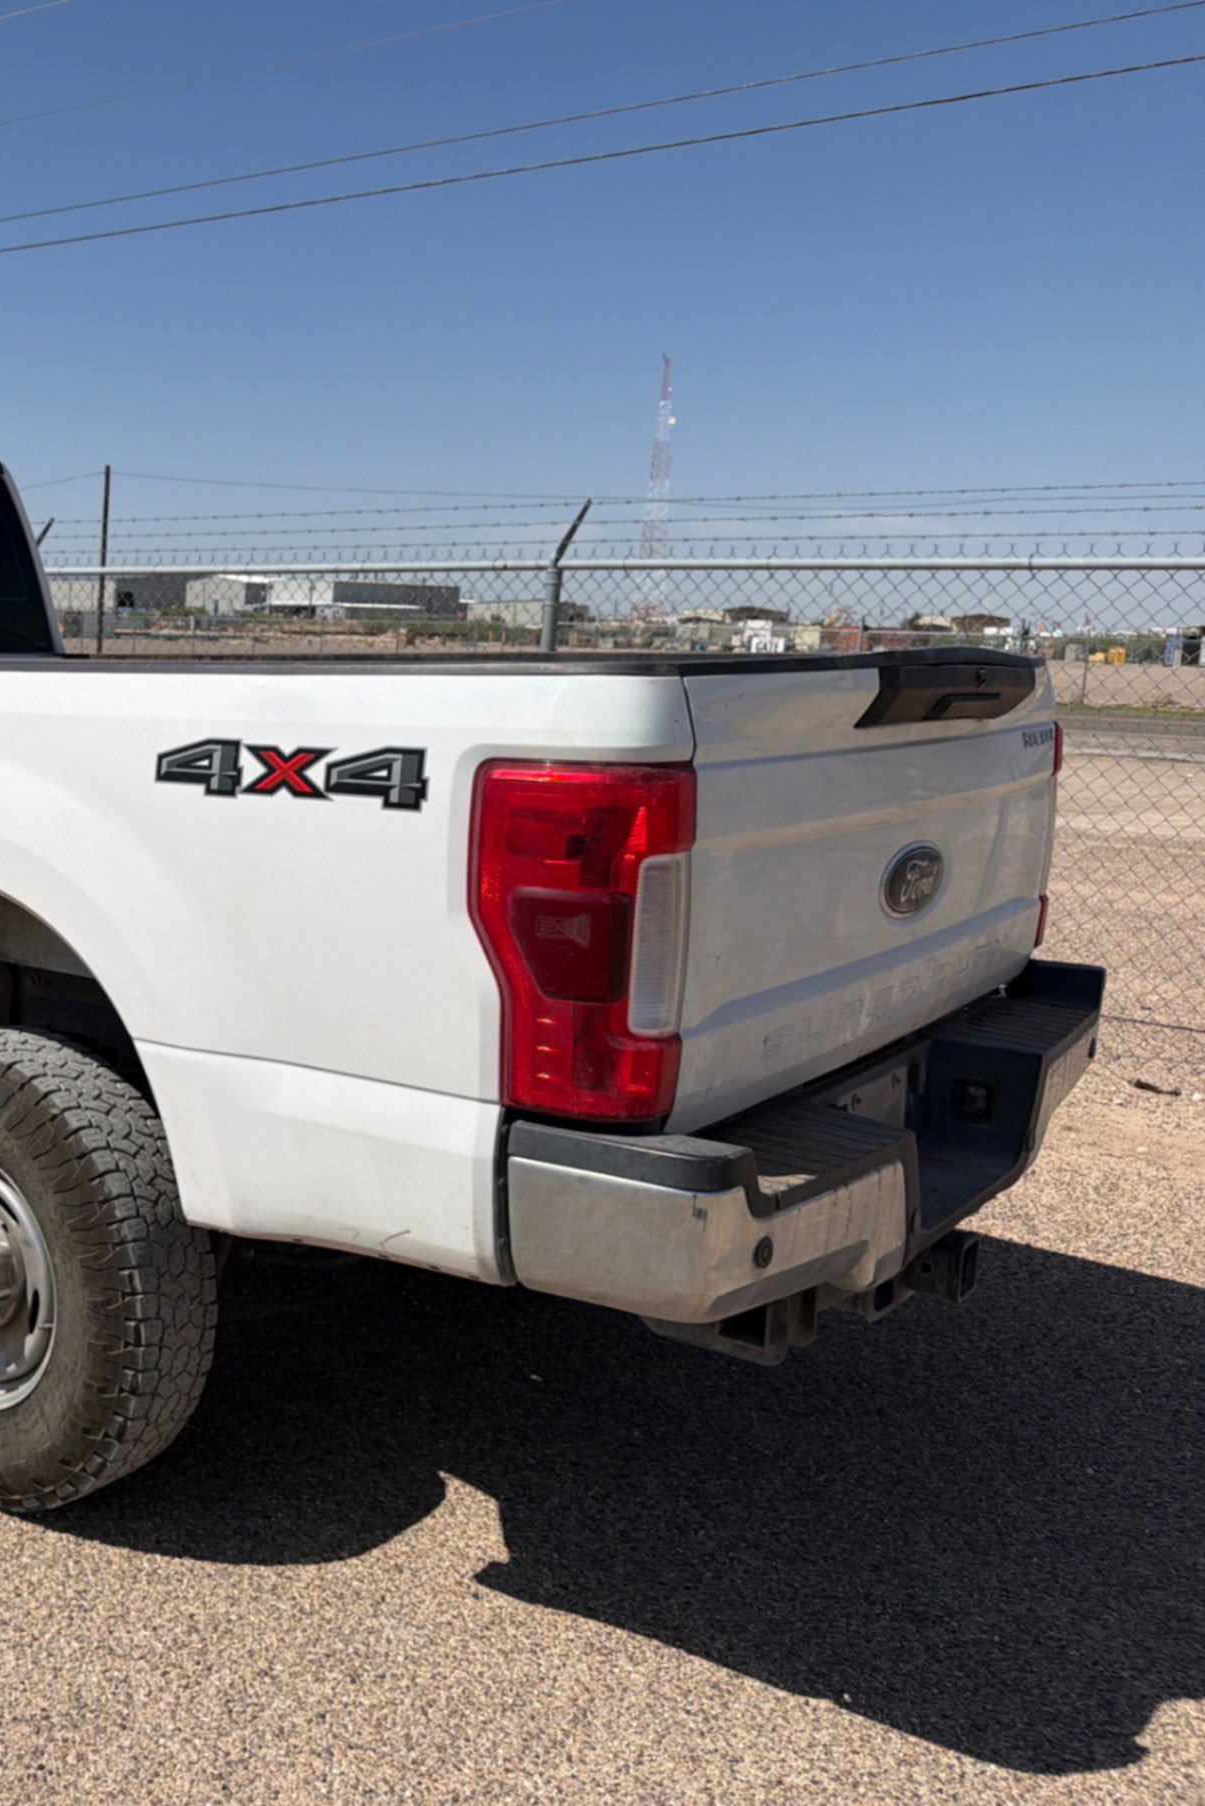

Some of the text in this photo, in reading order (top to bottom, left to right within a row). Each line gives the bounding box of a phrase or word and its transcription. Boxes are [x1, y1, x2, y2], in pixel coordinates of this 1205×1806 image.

[155, 738, 429, 812] 4X4
[900, 859, 939, 903] Ford
[761, 974, 922, 1059] SUPER
